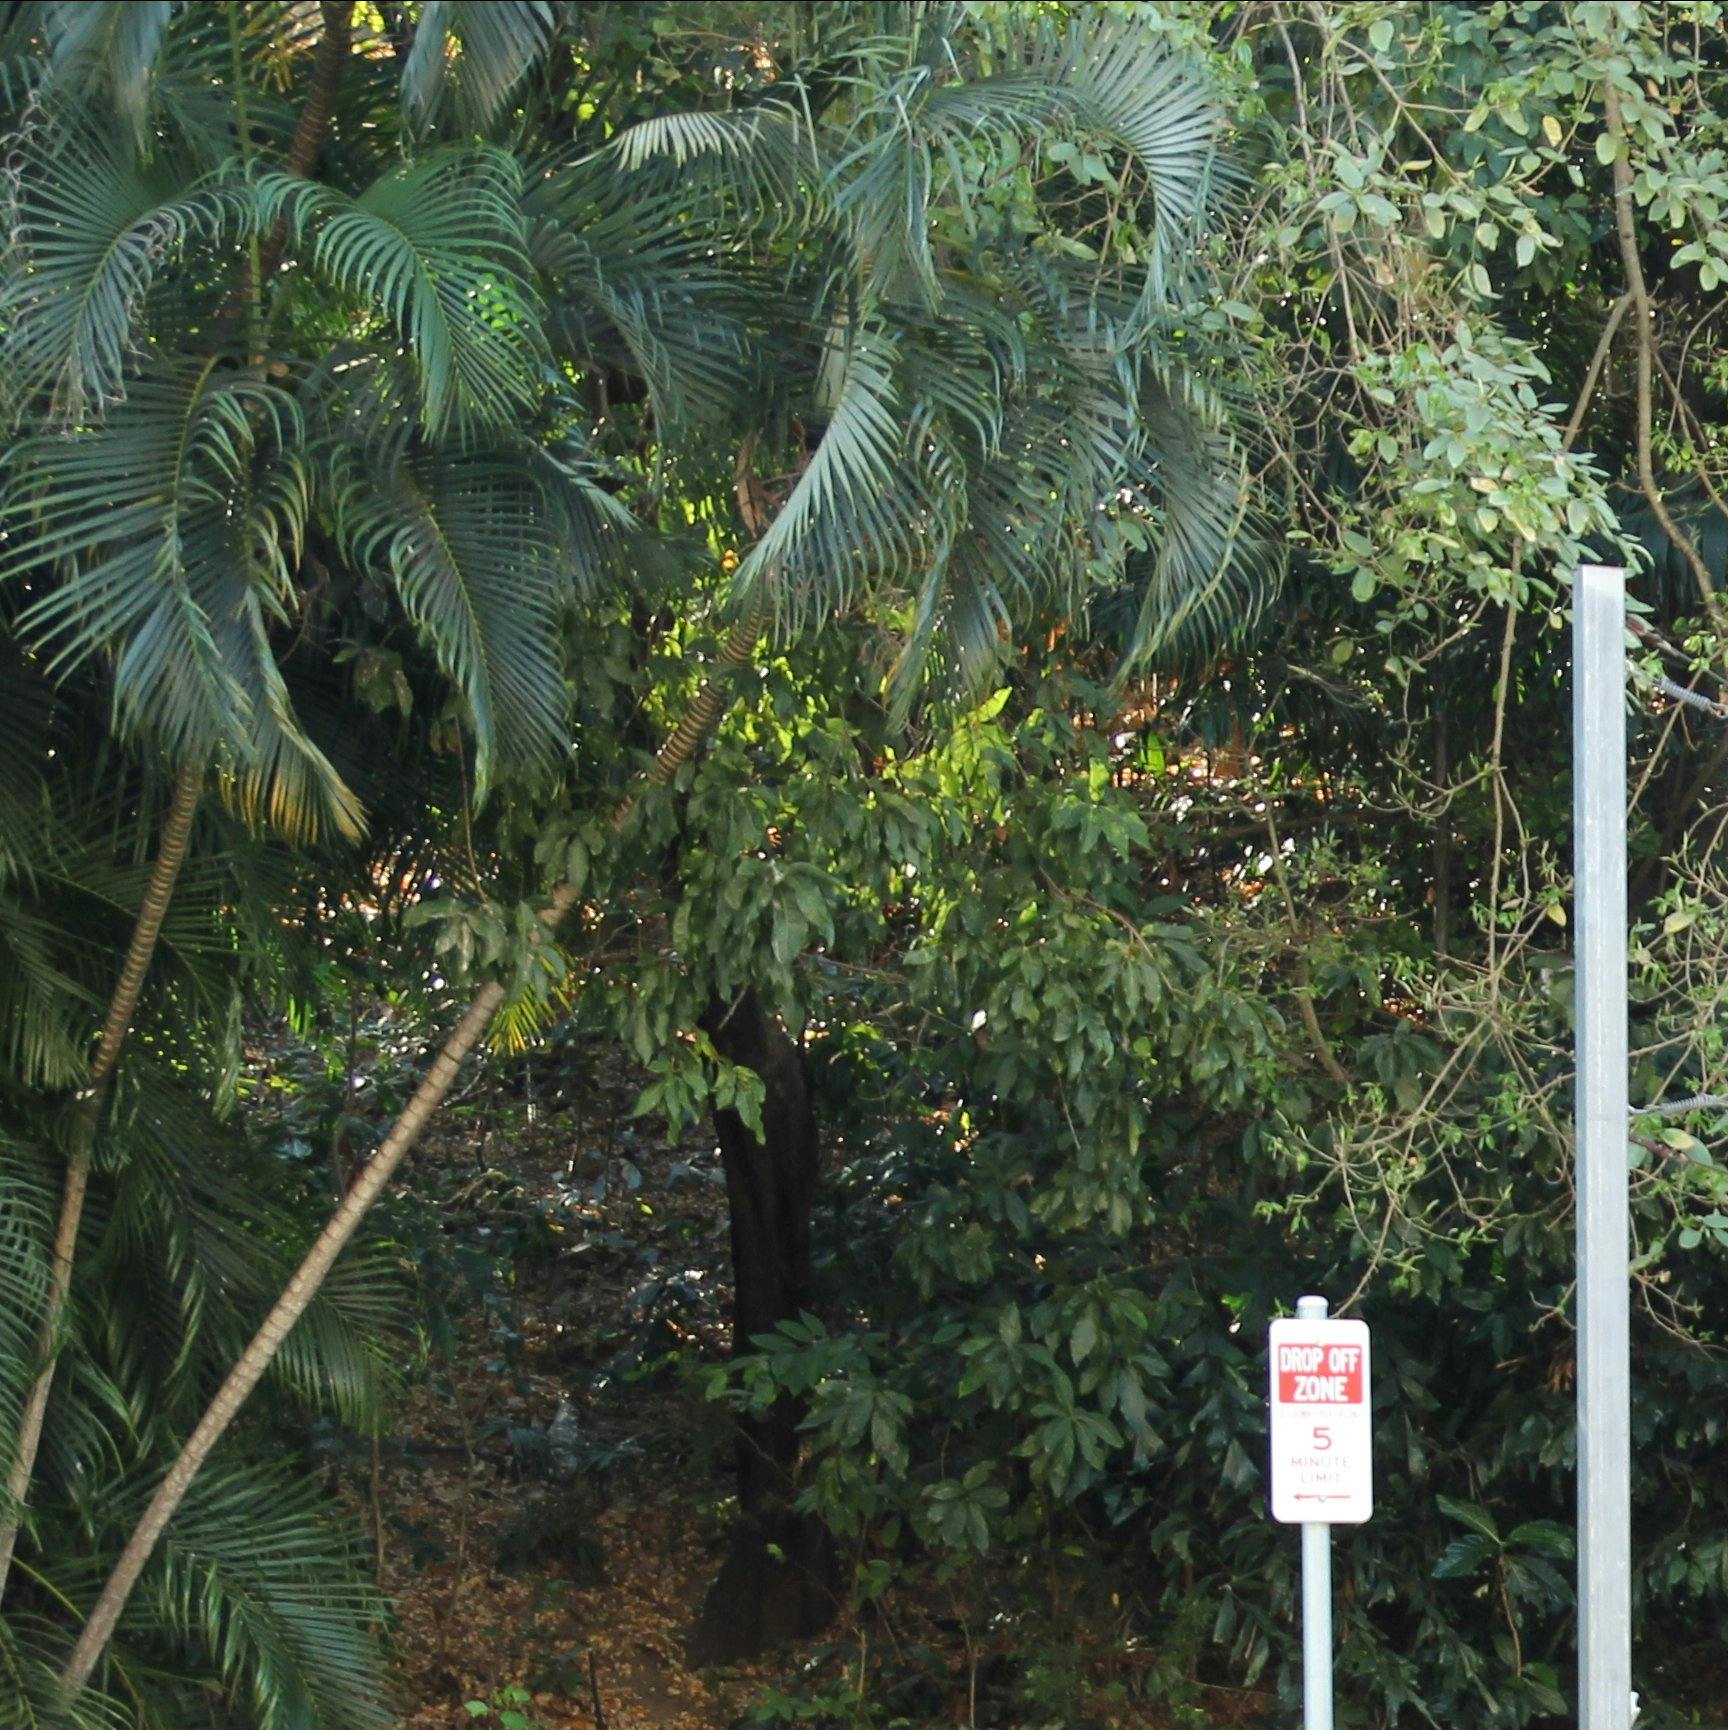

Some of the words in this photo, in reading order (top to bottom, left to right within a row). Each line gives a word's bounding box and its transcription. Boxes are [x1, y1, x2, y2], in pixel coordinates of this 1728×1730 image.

[1281, 1347, 1324, 1372] DROP
[1329, 1348, 1360, 1372] OFF
[1294, 1376, 1348, 1402] ZONE
[1312, 1427, 1332, 1450] 5
[1291, 1456, 1350, 1468] MINUTE
[1301, 1472, 1342, 1483] LIMIT
